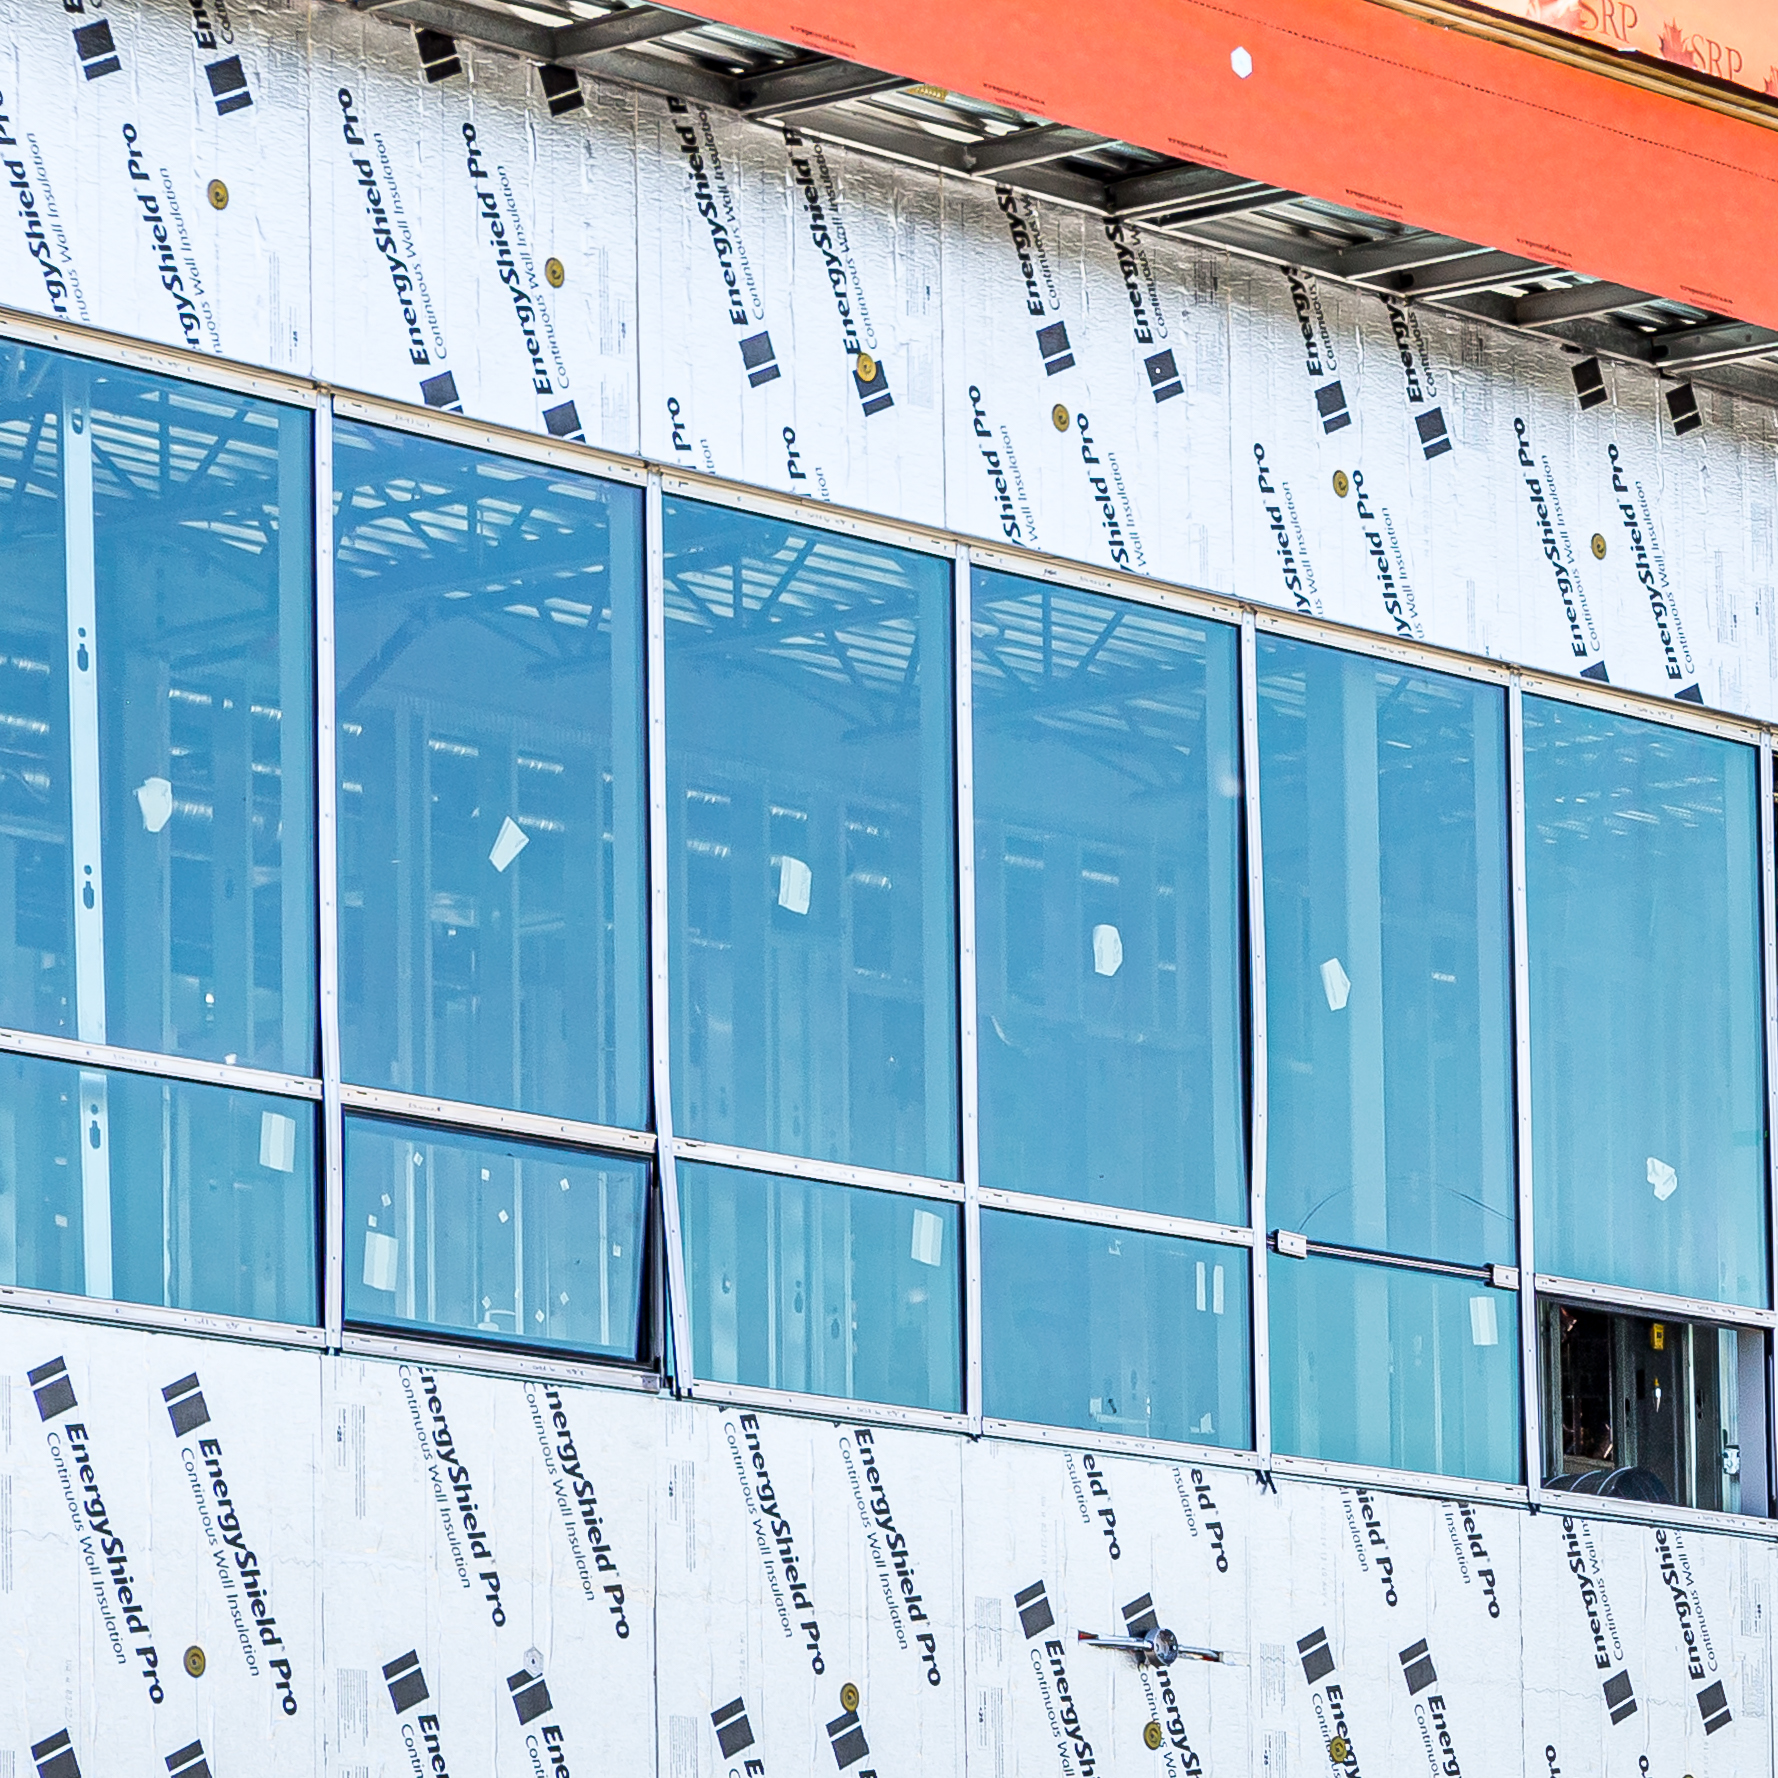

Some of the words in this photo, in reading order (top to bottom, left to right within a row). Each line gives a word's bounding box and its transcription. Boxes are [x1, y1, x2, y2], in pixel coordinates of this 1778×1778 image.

[1582, 0, 1637, 42] SRP
[1692, 34, 1742, 81] SRP
[338, 88, 365, 146] Pro
[462, 123, 488, 178] Pro
[27, 133, 59, 219] Insulation
[159, 167, 190, 253] Insulation
[373, 133, 404, 217] Insulation
[497, 164, 530, 252] Insulation
[356, 158, 429, 366] EnergyShield
[395, 225, 417, 259] Wall
[680, 125, 749, 325] EnergyShield
[792, 155, 860, 355] EnergyShield
[411, 262, 447, 359] Continuous
[481, 191, 554, 395] EnergyShield
[522, 255, 543, 289] Wall
[731, 226, 764, 320] Continuous
[536, 292, 569, 389] Continuous
[667, 397, 692, 451] Pro
[968, 386, 991, 439] Pro
[1513, 417, 1535, 466] Pro
[1000, 425, 1029, 504] Insulation
[1109, 451, 1135, 530] Insulation
[1353, 470, 1375, 520] Pro
[1540, 454, 1566, 529] Insulation
[1607, 444, 1629, 492] Pro
[1281, 480, 1307, 559] Insulation
[1556, 531, 1577, 563] Wall
[1635, 480, 1661, 554] Insulation
[1527, 477, 1588, 657] EnergyShield
[1570, 565, 1601, 651] Continuous
[1621, 499, 1682, 680] EnergyShield
[1665, 588, 1695, 674] Continuous
[47, 1431, 85, 1530] Continuous
[80, 1537, 101, 1583] Wall
[91, 1581, 128, 1665] Insulation
[65, 1422, 146, 1635] EnergyShield
[135, 1644, 165, 1705] Pro
[181, 1447, 219, 1547] Continuous
[214, 1551, 235, 1593] Wall
[226, 1596, 260, 1677] Insulation
[724, 1421, 759, 1515] Continuous
[752, 1519, 770, 1559] Wall
[763, 1559, 794, 1639] Insulation
[740, 1413, 811, 1610] EnergyShield
[800, 1620, 826, 1676] Pro
[854, 1428, 928, 1623] EnergyShield
[916, 1633, 943, 1687] Pro
[1204, 1520, 1229, 1574] Pro
[199, 1438, 282, 1648] EnergyShield
[269, 1658, 299, 1717] Pro
[481, 1571, 506, 1628] Pro
[1375, 1556, 1398, 1609] Pro
[1029, 1649, 1063, 1738] Continuous
